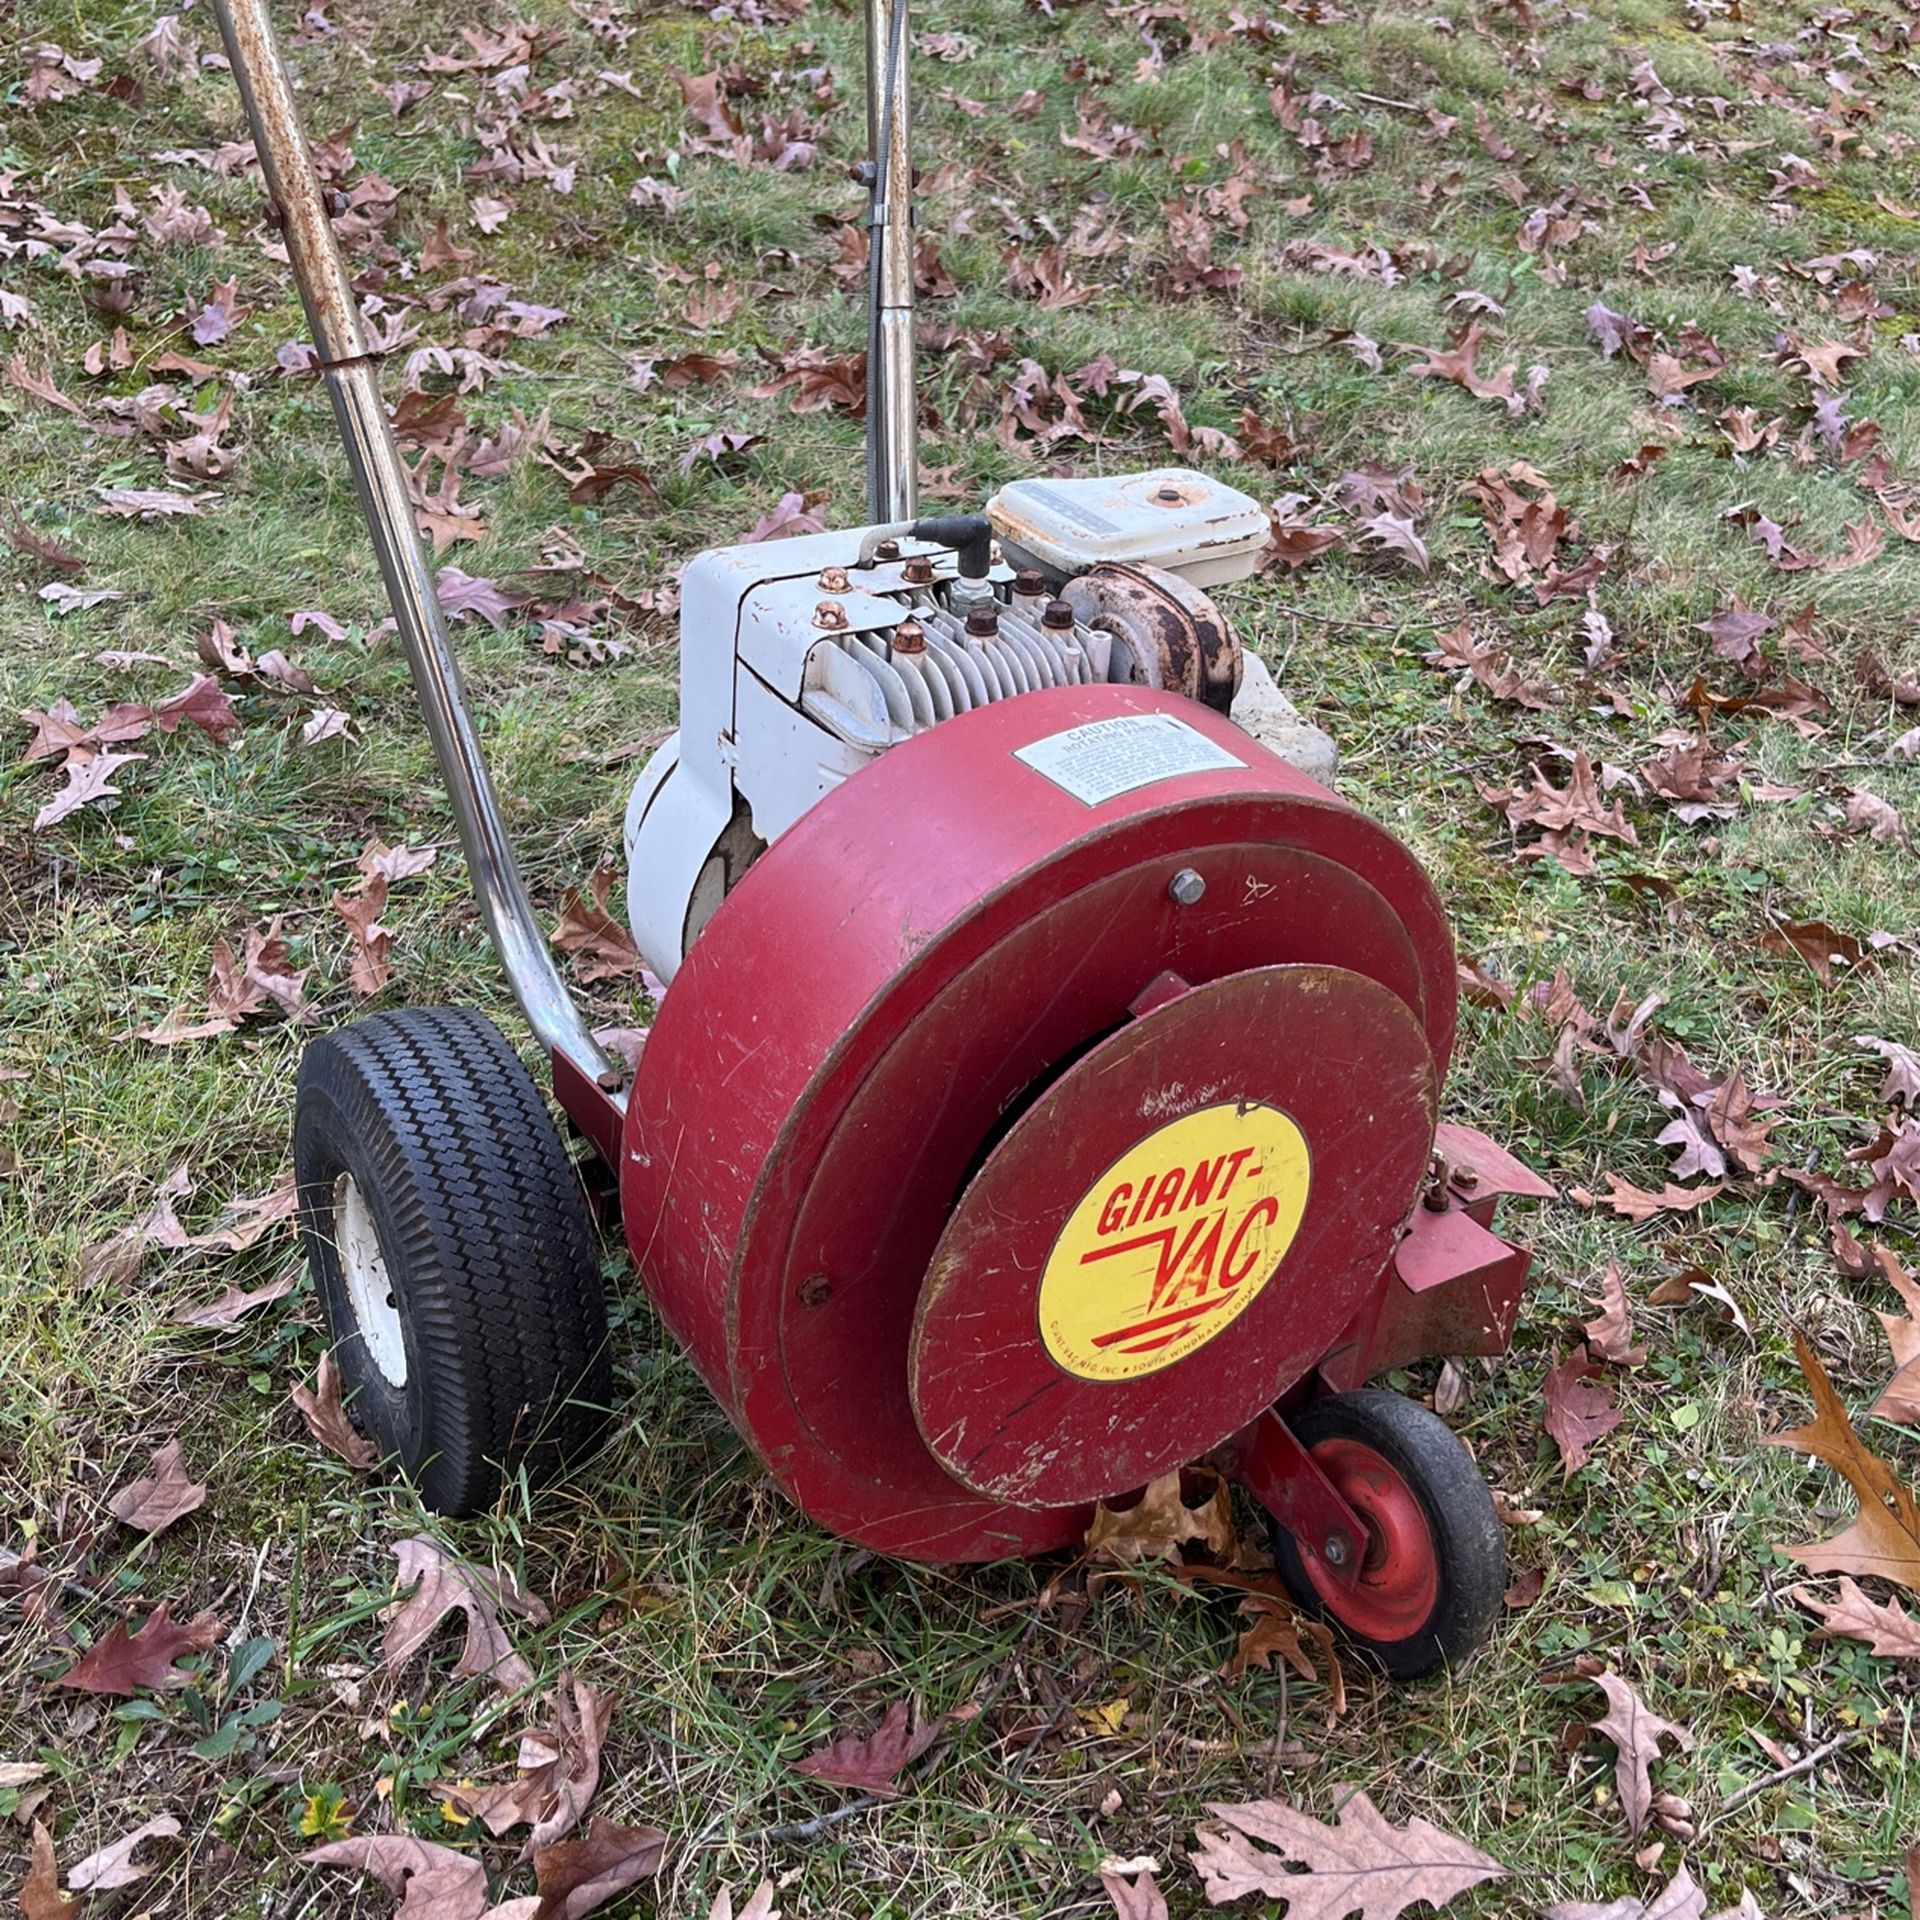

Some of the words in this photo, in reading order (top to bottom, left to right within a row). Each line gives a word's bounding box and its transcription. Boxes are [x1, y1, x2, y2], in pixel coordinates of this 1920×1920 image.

[1063, 730, 1124, 753] ROTATING
[1067, 719, 1139, 741] CAUTION
[1097, 1146, 1264, 1236] GIANT-
[1079, 1196, 1279, 1315] VAC
[1132, 1356, 1166, 1372] SOUTH
[1170, 1320, 1223, 1359] WINDHAM
